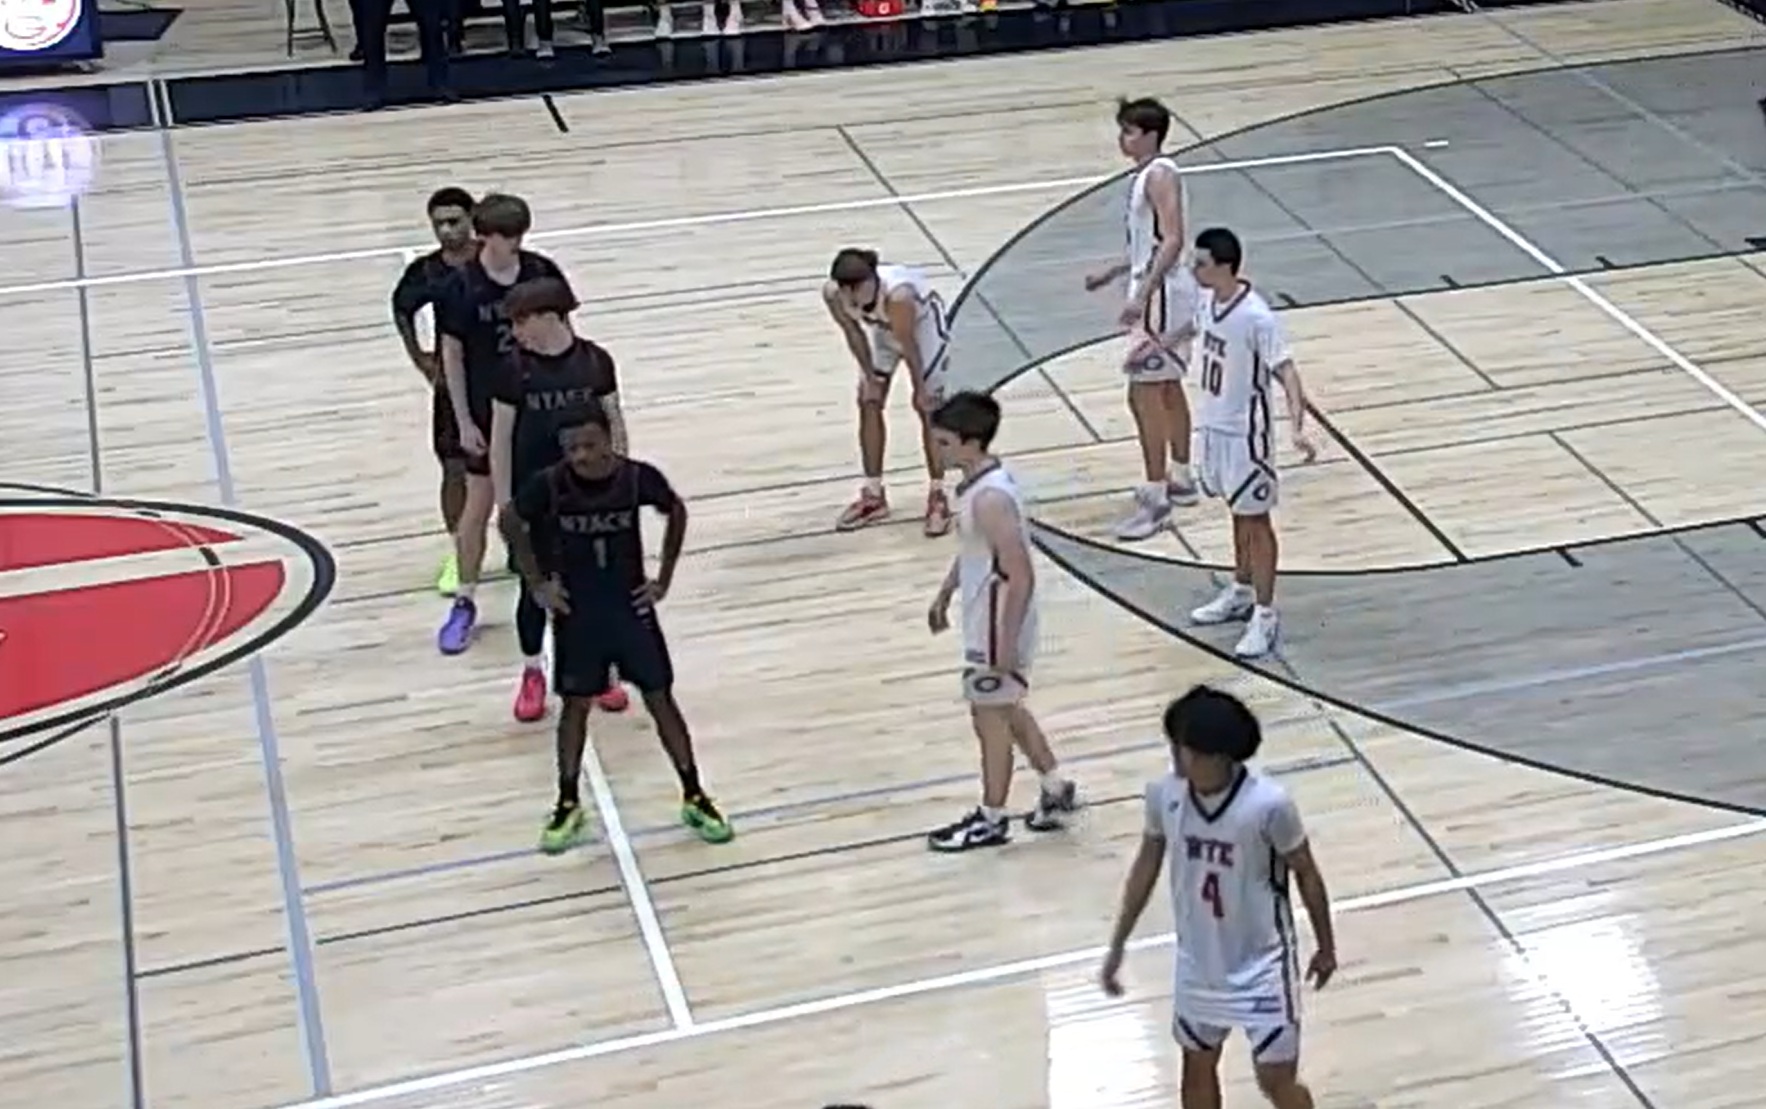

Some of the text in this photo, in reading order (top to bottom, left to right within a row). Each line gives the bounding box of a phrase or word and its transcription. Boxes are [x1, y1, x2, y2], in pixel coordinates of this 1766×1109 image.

[1201, 354, 1223, 397] 10
[593, 537, 608, 570] 1
[1201, 871, 1224, 919] 4
